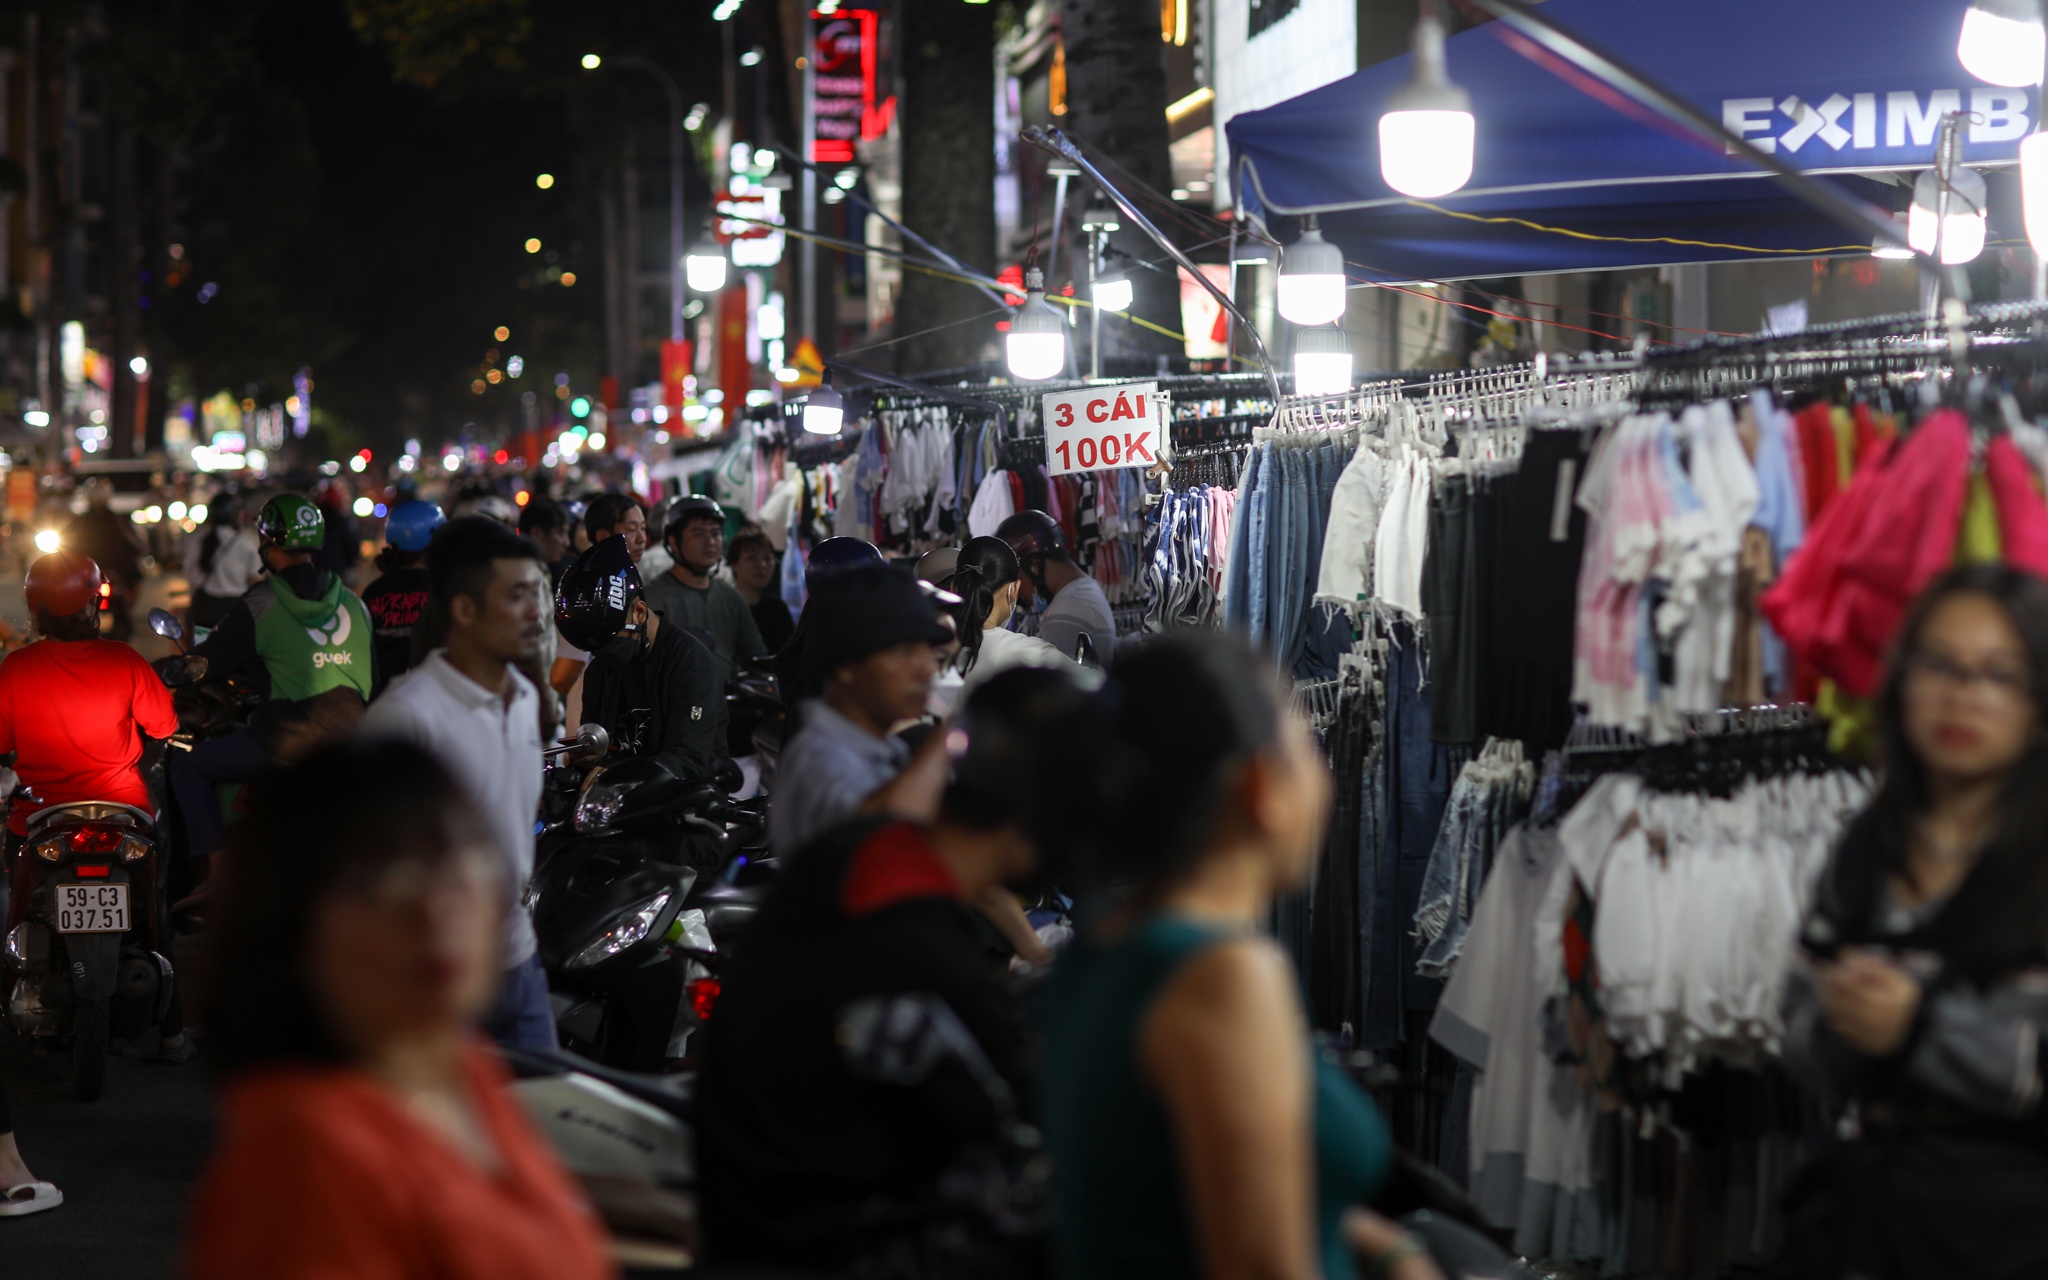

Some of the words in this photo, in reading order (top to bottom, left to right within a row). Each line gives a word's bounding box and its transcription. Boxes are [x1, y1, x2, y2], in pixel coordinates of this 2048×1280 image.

[1723, 88, 2039, 155] EXIMB
[1055, 403, 1075, 428] 3
[1086, 390, 1146, 423] CÁI
[1055, 431, 1154, 470] 100K
[67, 887, 119, 908] 59-C3
[61, 908, 124, 930] 037.51
